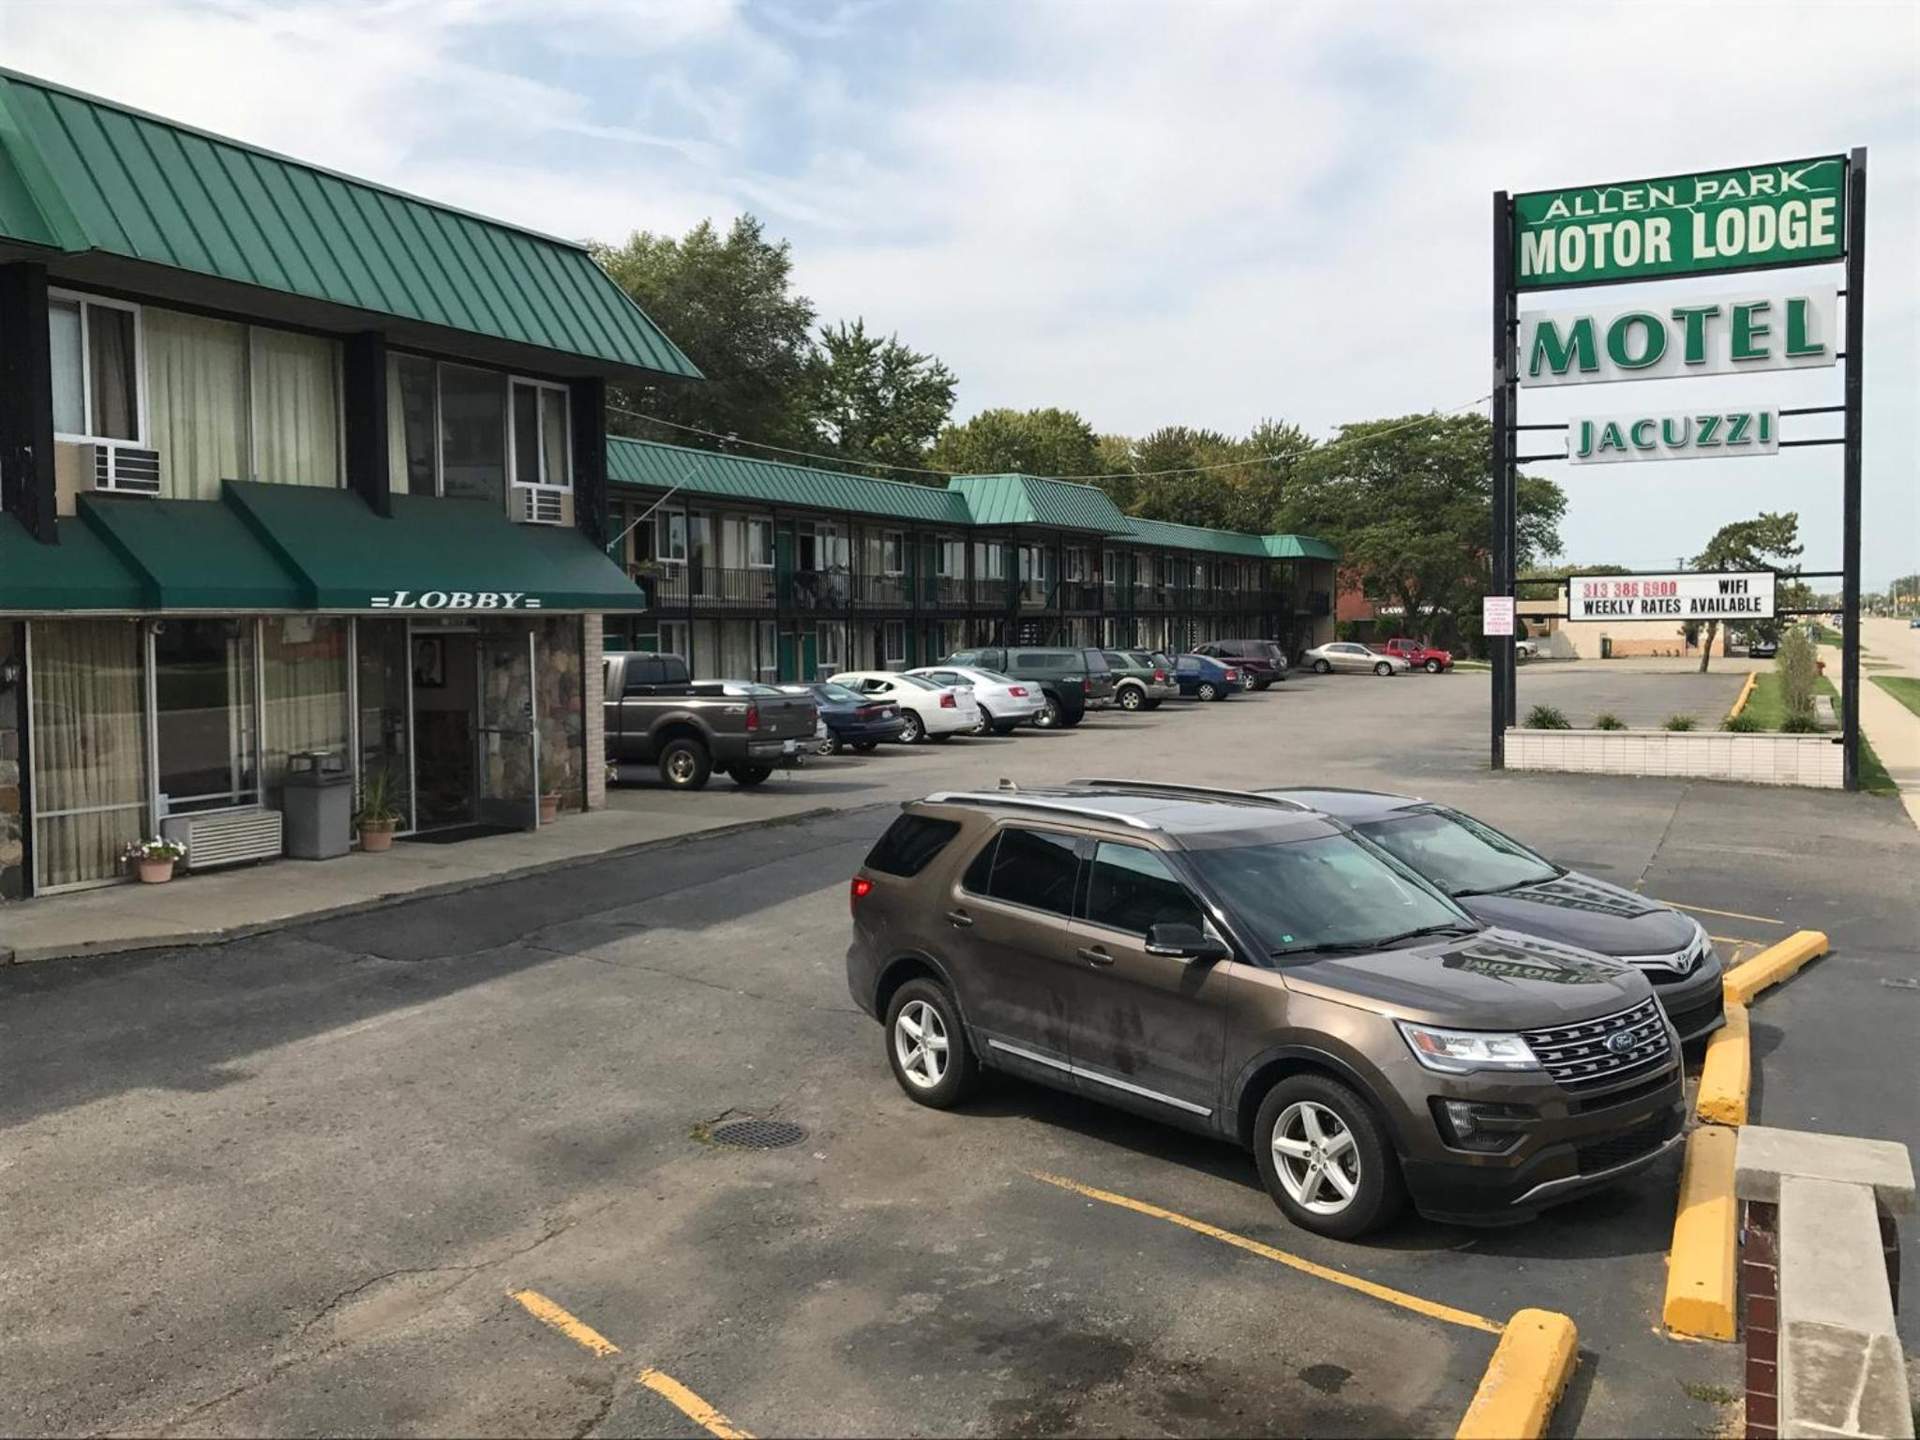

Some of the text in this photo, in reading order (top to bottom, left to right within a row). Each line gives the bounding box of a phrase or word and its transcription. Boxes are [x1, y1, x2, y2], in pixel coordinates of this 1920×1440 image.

[1543, 168, 1813, 219] ALLEN PARK
[1520, 197, 1836, 276] MOTOR LODGE
[1529, 297, 1826, 376] MOTEL
[1576, 411, 1771, 458] JACUZZI
[389, 590, 526, 609] LOBBY
[1584, 583, 1608, 598] 313
[1718, 579, 1748, 594] WIFI
[1584, 597, 1762, 615] WEEKLY RATES AVAILABLE
